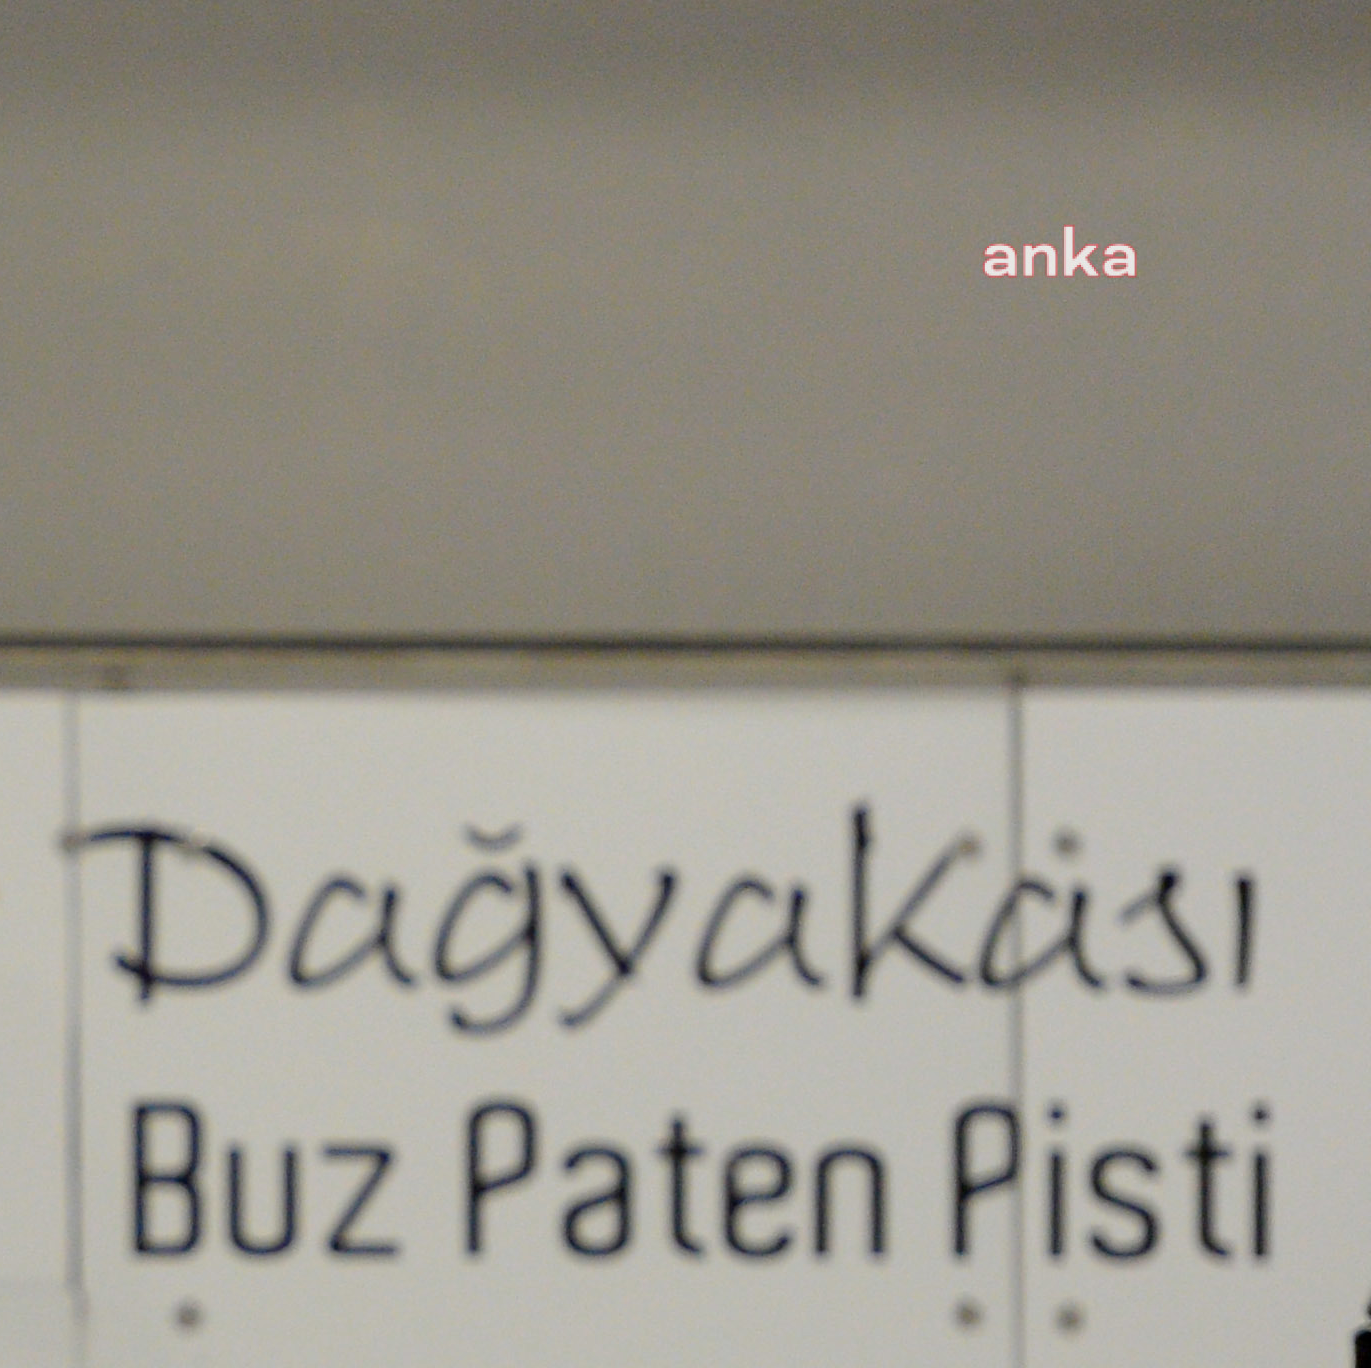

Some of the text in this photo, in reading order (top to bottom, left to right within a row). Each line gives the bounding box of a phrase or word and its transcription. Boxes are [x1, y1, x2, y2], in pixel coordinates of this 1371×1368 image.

[55, 800, 1255, 1037] Dağyakası
[129, 1098, 1273, 1259] Buz Paten Pisti
